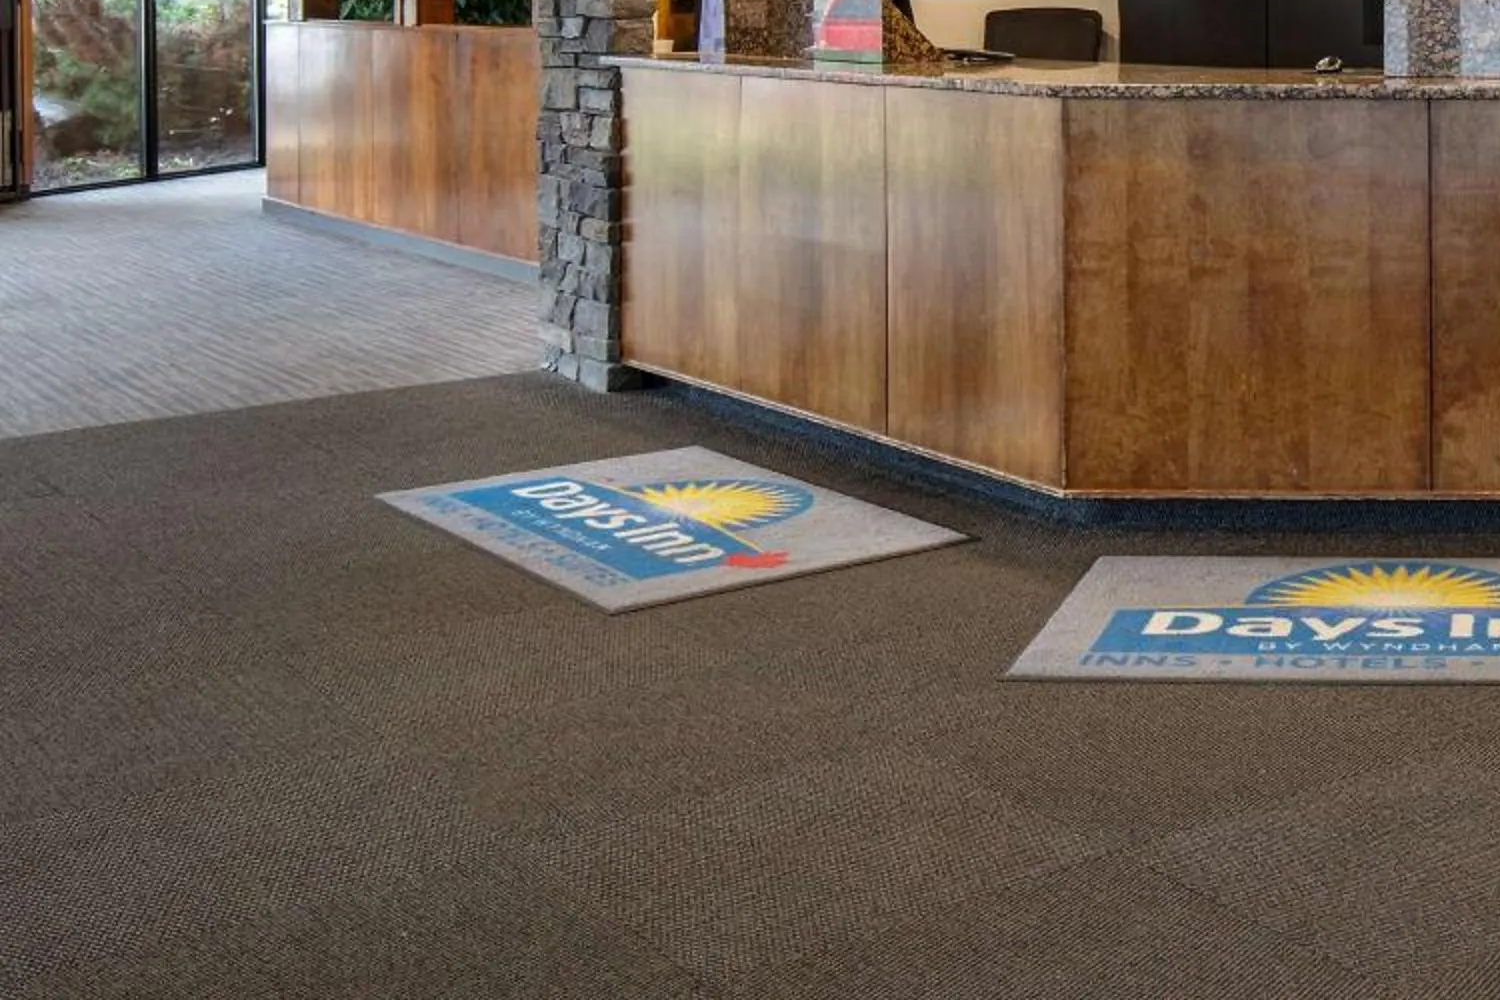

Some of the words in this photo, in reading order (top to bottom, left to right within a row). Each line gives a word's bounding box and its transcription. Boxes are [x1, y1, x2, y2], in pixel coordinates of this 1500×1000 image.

[510, 481, 647, 529] Days
[613, 522, 725, 564] Inn
[1141, 611, 1425, 641] Days
[1257, 640, 1303, 651] BY
[1079, 654, 1198, 667] INNS
[1253, 655, 1448, 670] HOTELS
